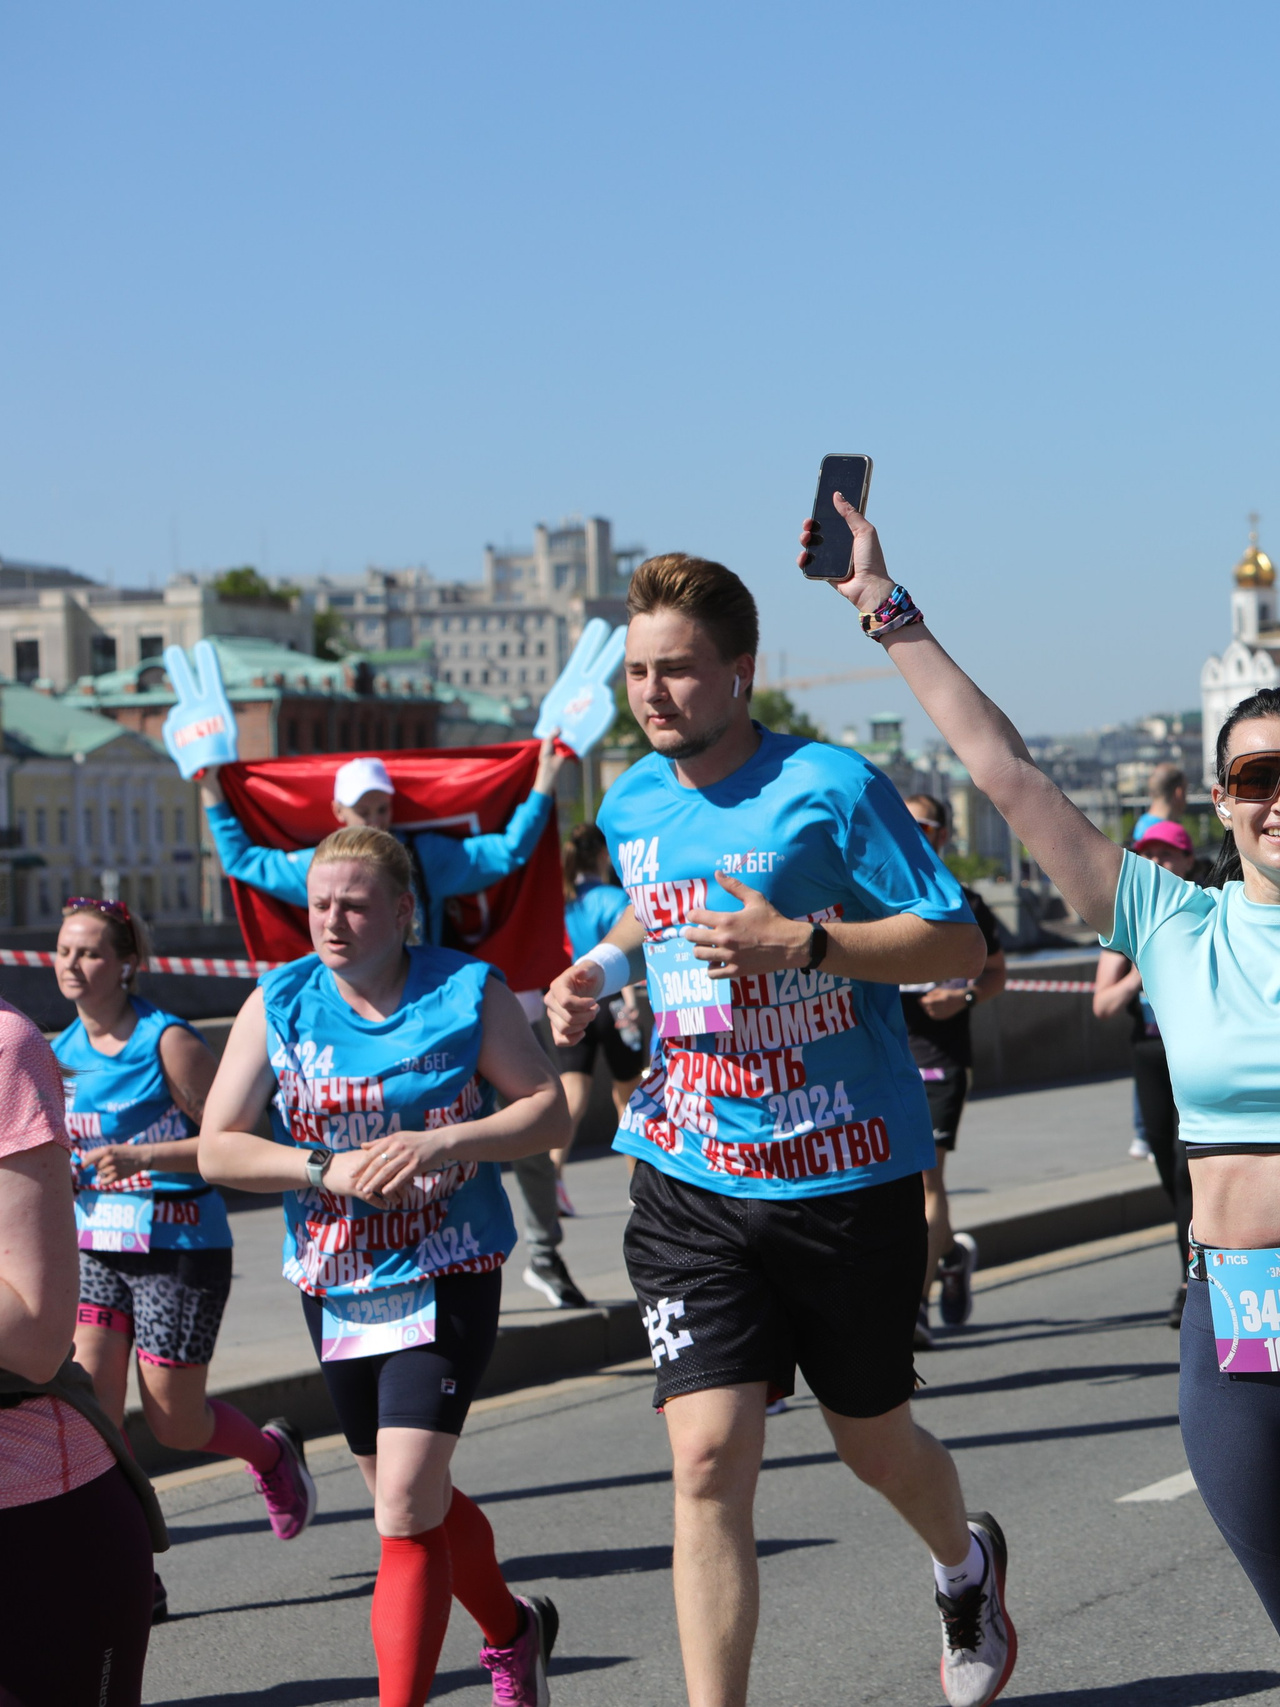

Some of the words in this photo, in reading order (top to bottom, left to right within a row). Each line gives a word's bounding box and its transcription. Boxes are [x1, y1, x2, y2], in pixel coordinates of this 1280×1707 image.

[662, 967, 713, 1006] 30435
[675, 1006, 706, 1036] 10KM
[769, 1080, 855, 1139] 2024
[702, 1116, 891, 1179] #ЕДИНСТВО
[416, 1221, 480, 1271] 2024
[1225, 1255, 1248, 1265] ПСБ
[346, 1291, 416, 1331] 32587
